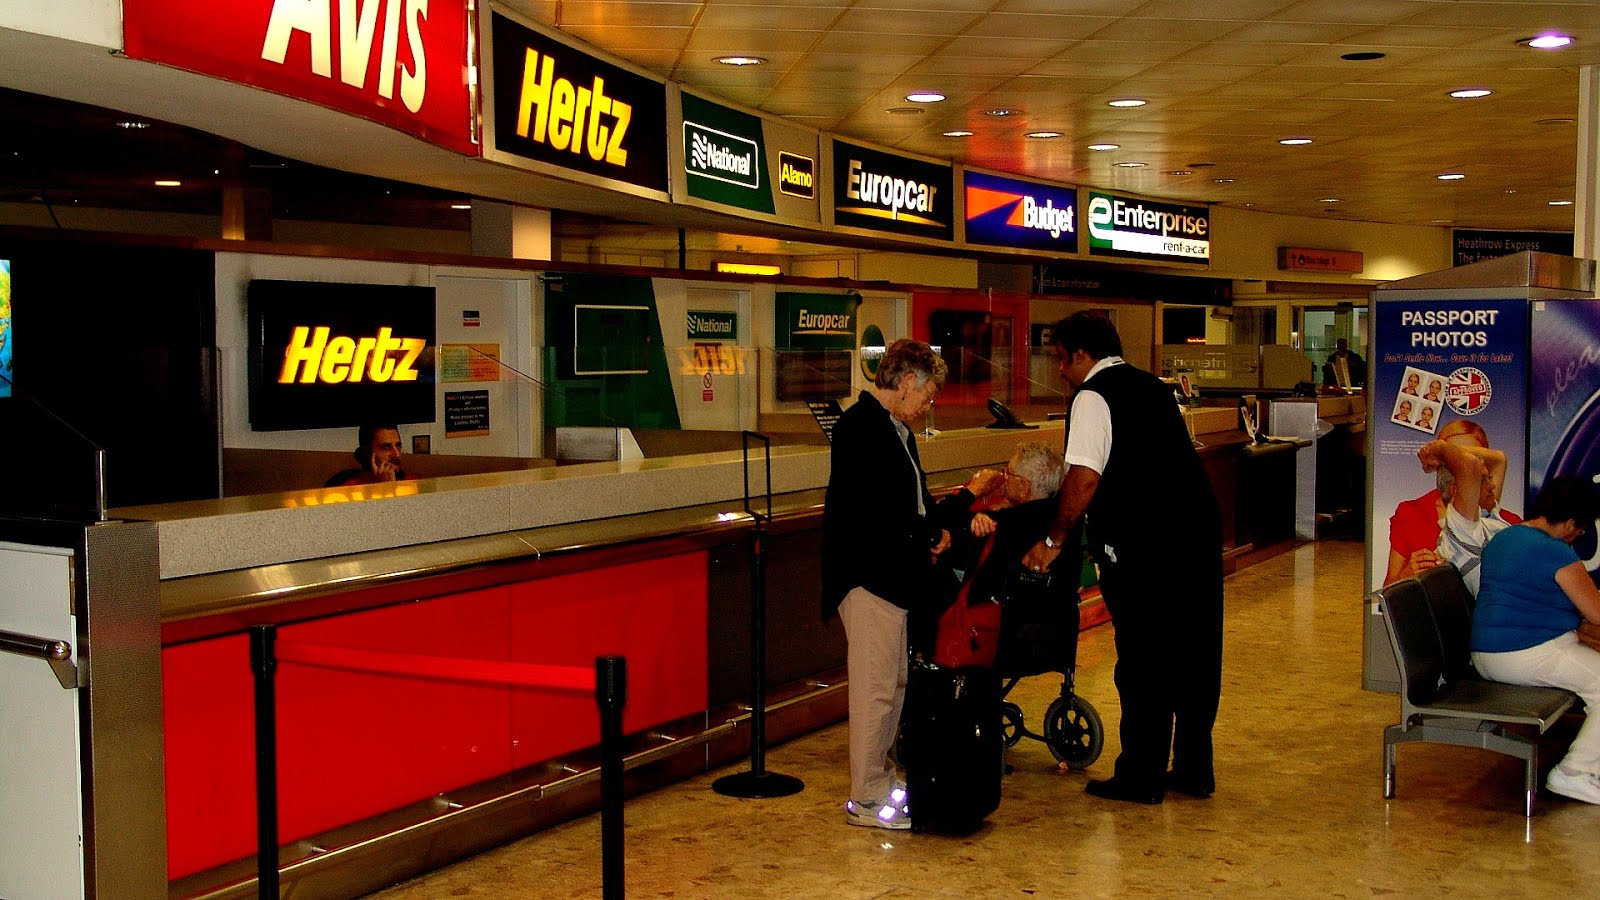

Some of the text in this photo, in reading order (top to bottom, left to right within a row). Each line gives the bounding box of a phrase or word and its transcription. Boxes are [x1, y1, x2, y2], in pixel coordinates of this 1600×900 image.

[261, 0, 428, 113] AVIS
[516, 47, 632, 167] Hertz
[706, 140, 750, 176] National
[781, 163, 812, 188] Alamo
[847, 159, 937, 219] Europcar
[1023, 196, 1075, 239] Budget
[1113, 199, 1208, 237] Enterprise
[1457, 237, 1541, 252] Heathrow Express
[696, 318, 732, 333] National
[798, 308, 849, 331] Europcar
[1401, 309, 1499, 326] PASSPORT
[278, 326, 426, 384] Hertz
[1411, 331, 1488, 347] PHOTOS
